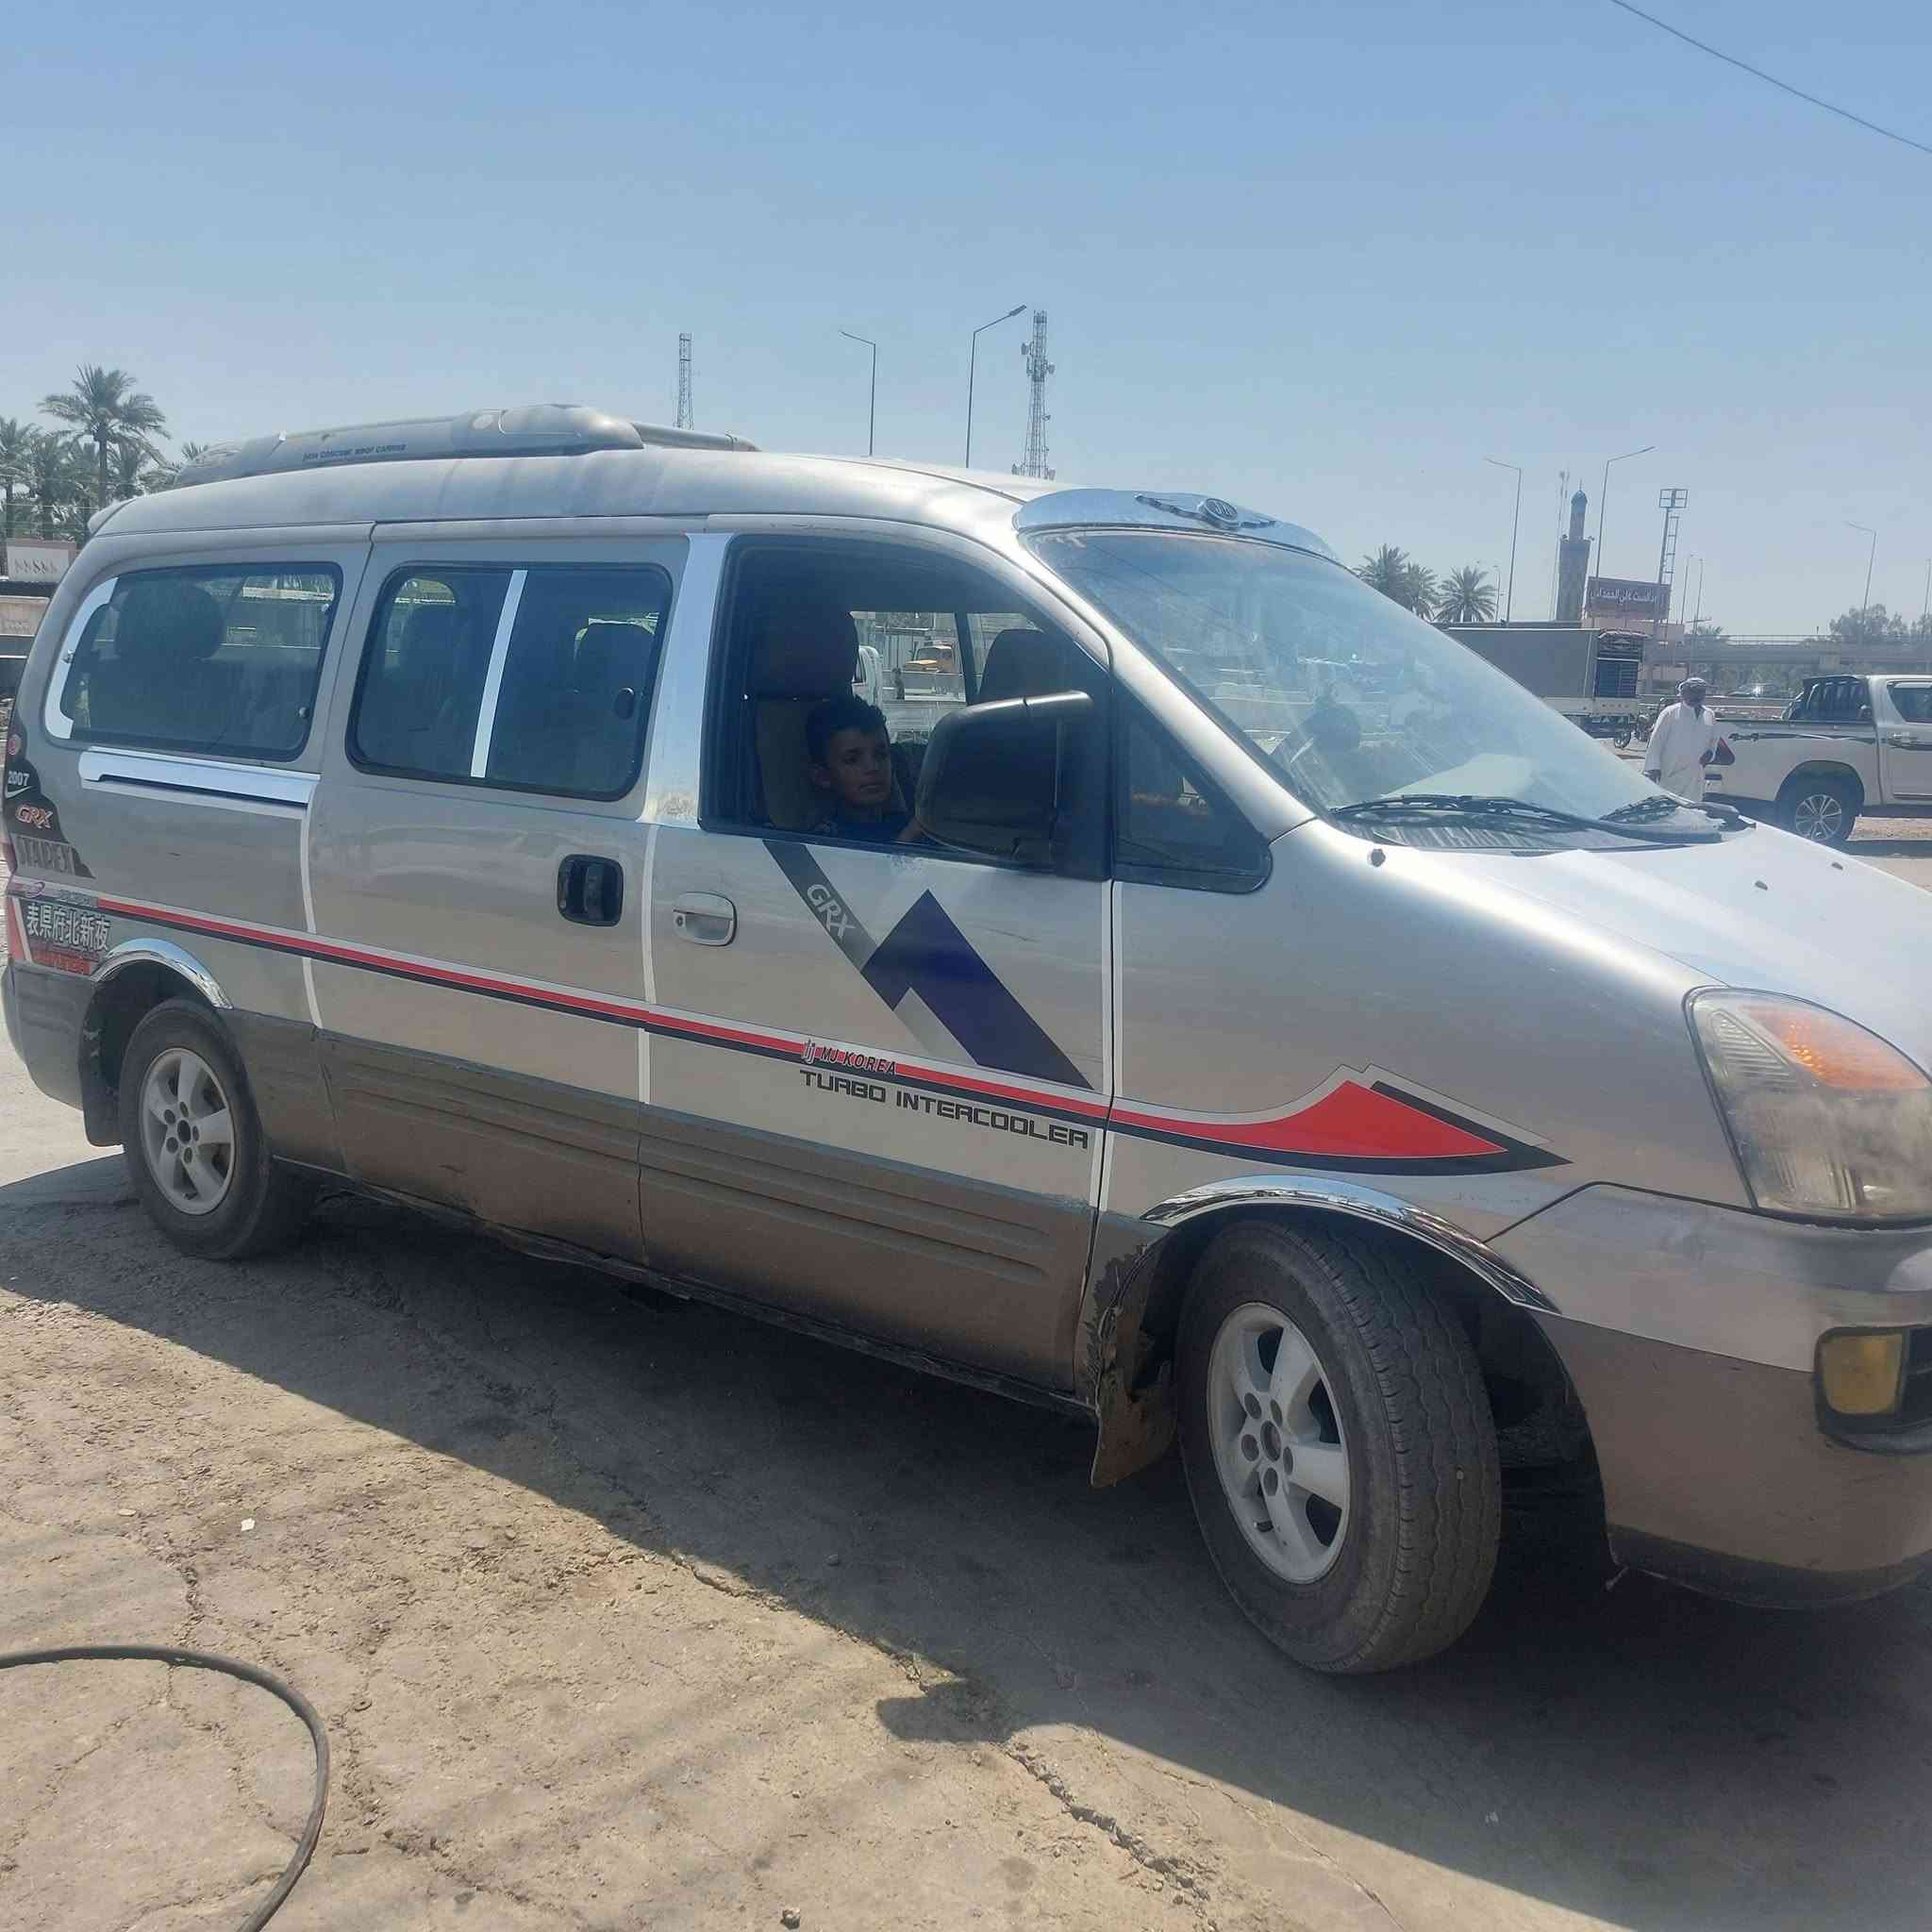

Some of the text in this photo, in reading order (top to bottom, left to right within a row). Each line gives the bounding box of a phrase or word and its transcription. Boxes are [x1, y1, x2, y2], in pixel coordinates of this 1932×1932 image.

[8, 771, 29, 786] 2007
[16, 805, 53, 828] GRX
[807, 884, 857, 941] GRX
[842, 1050, 897, 1075] KOREA
[800, 1070, 1089, 1149] TURBO INTERCOOLER
